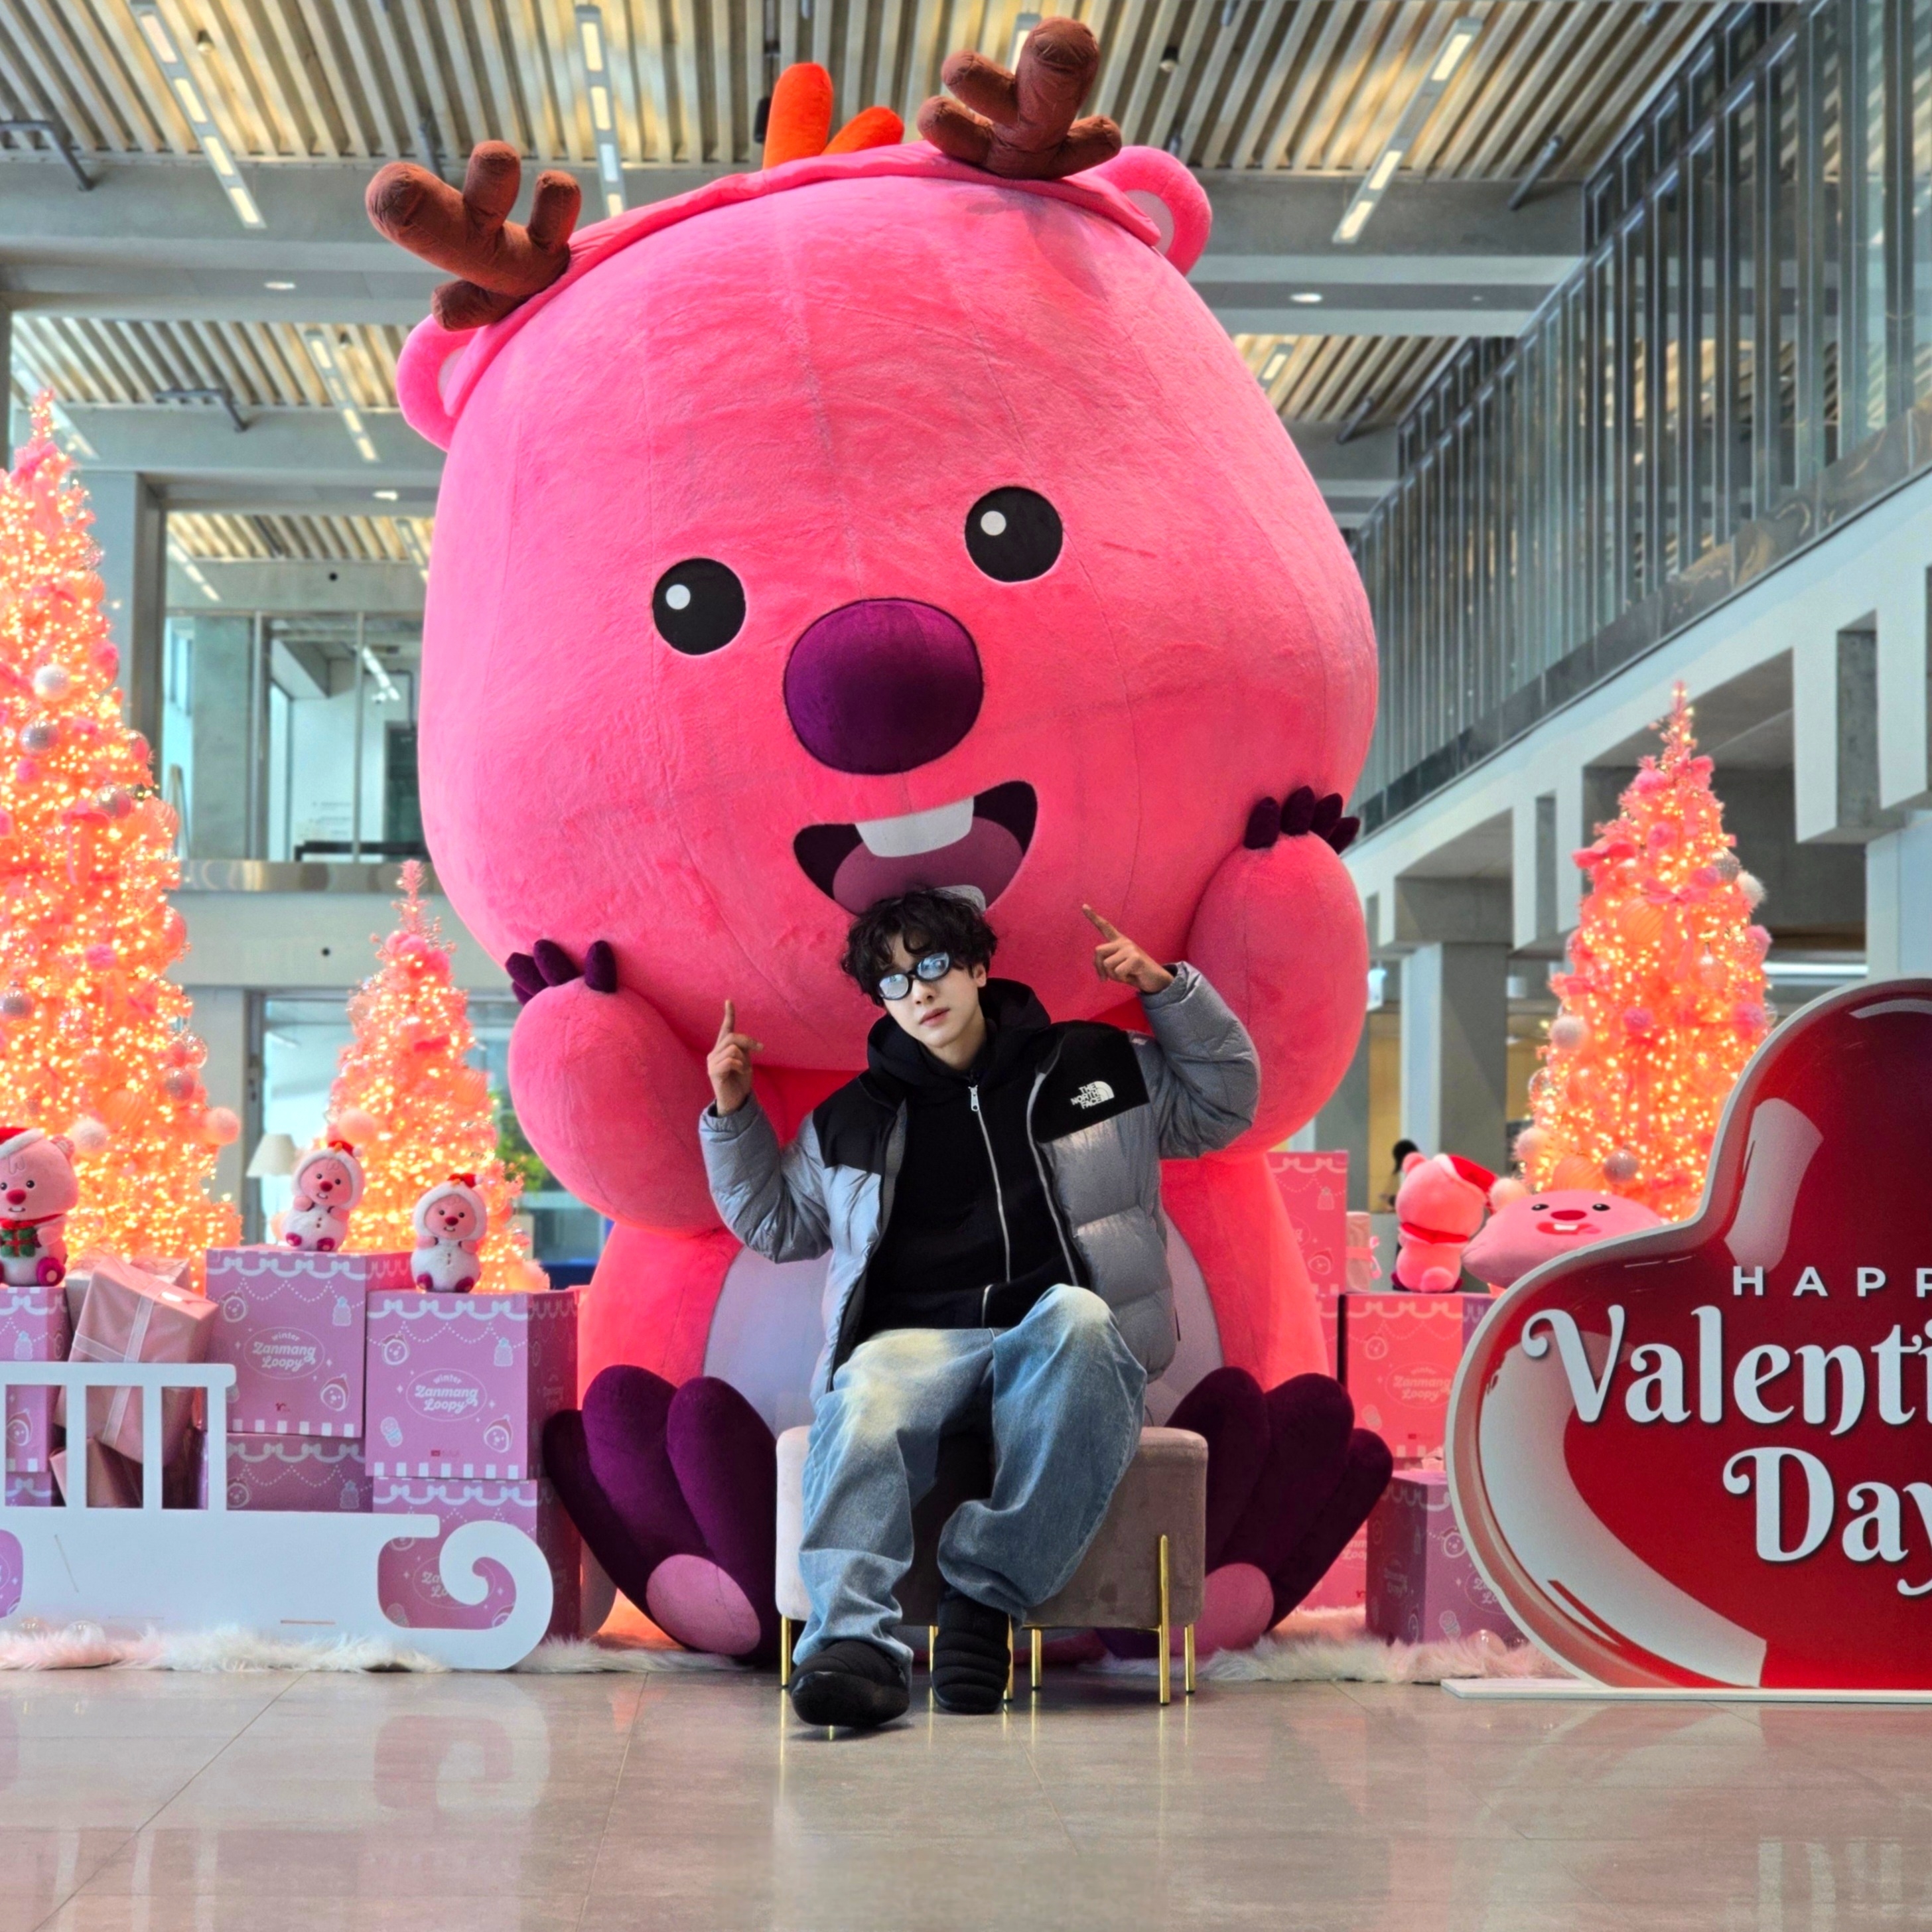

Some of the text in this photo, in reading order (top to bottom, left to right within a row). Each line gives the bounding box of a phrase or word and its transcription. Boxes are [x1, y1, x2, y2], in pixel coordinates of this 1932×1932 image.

[1079, 1081, 1097, 1094] THE
[1070, 1088, 1099, 1106] NORTH
[1081, 1097, 1102, 1110] FACE
[252, 1341, 316, 1365] Zanmang
[261, 1355, 303, 1372] Loopy
[415, 1385, 479, 1407] Zanmang
[423, 1398, 465, 1414] Loopy
